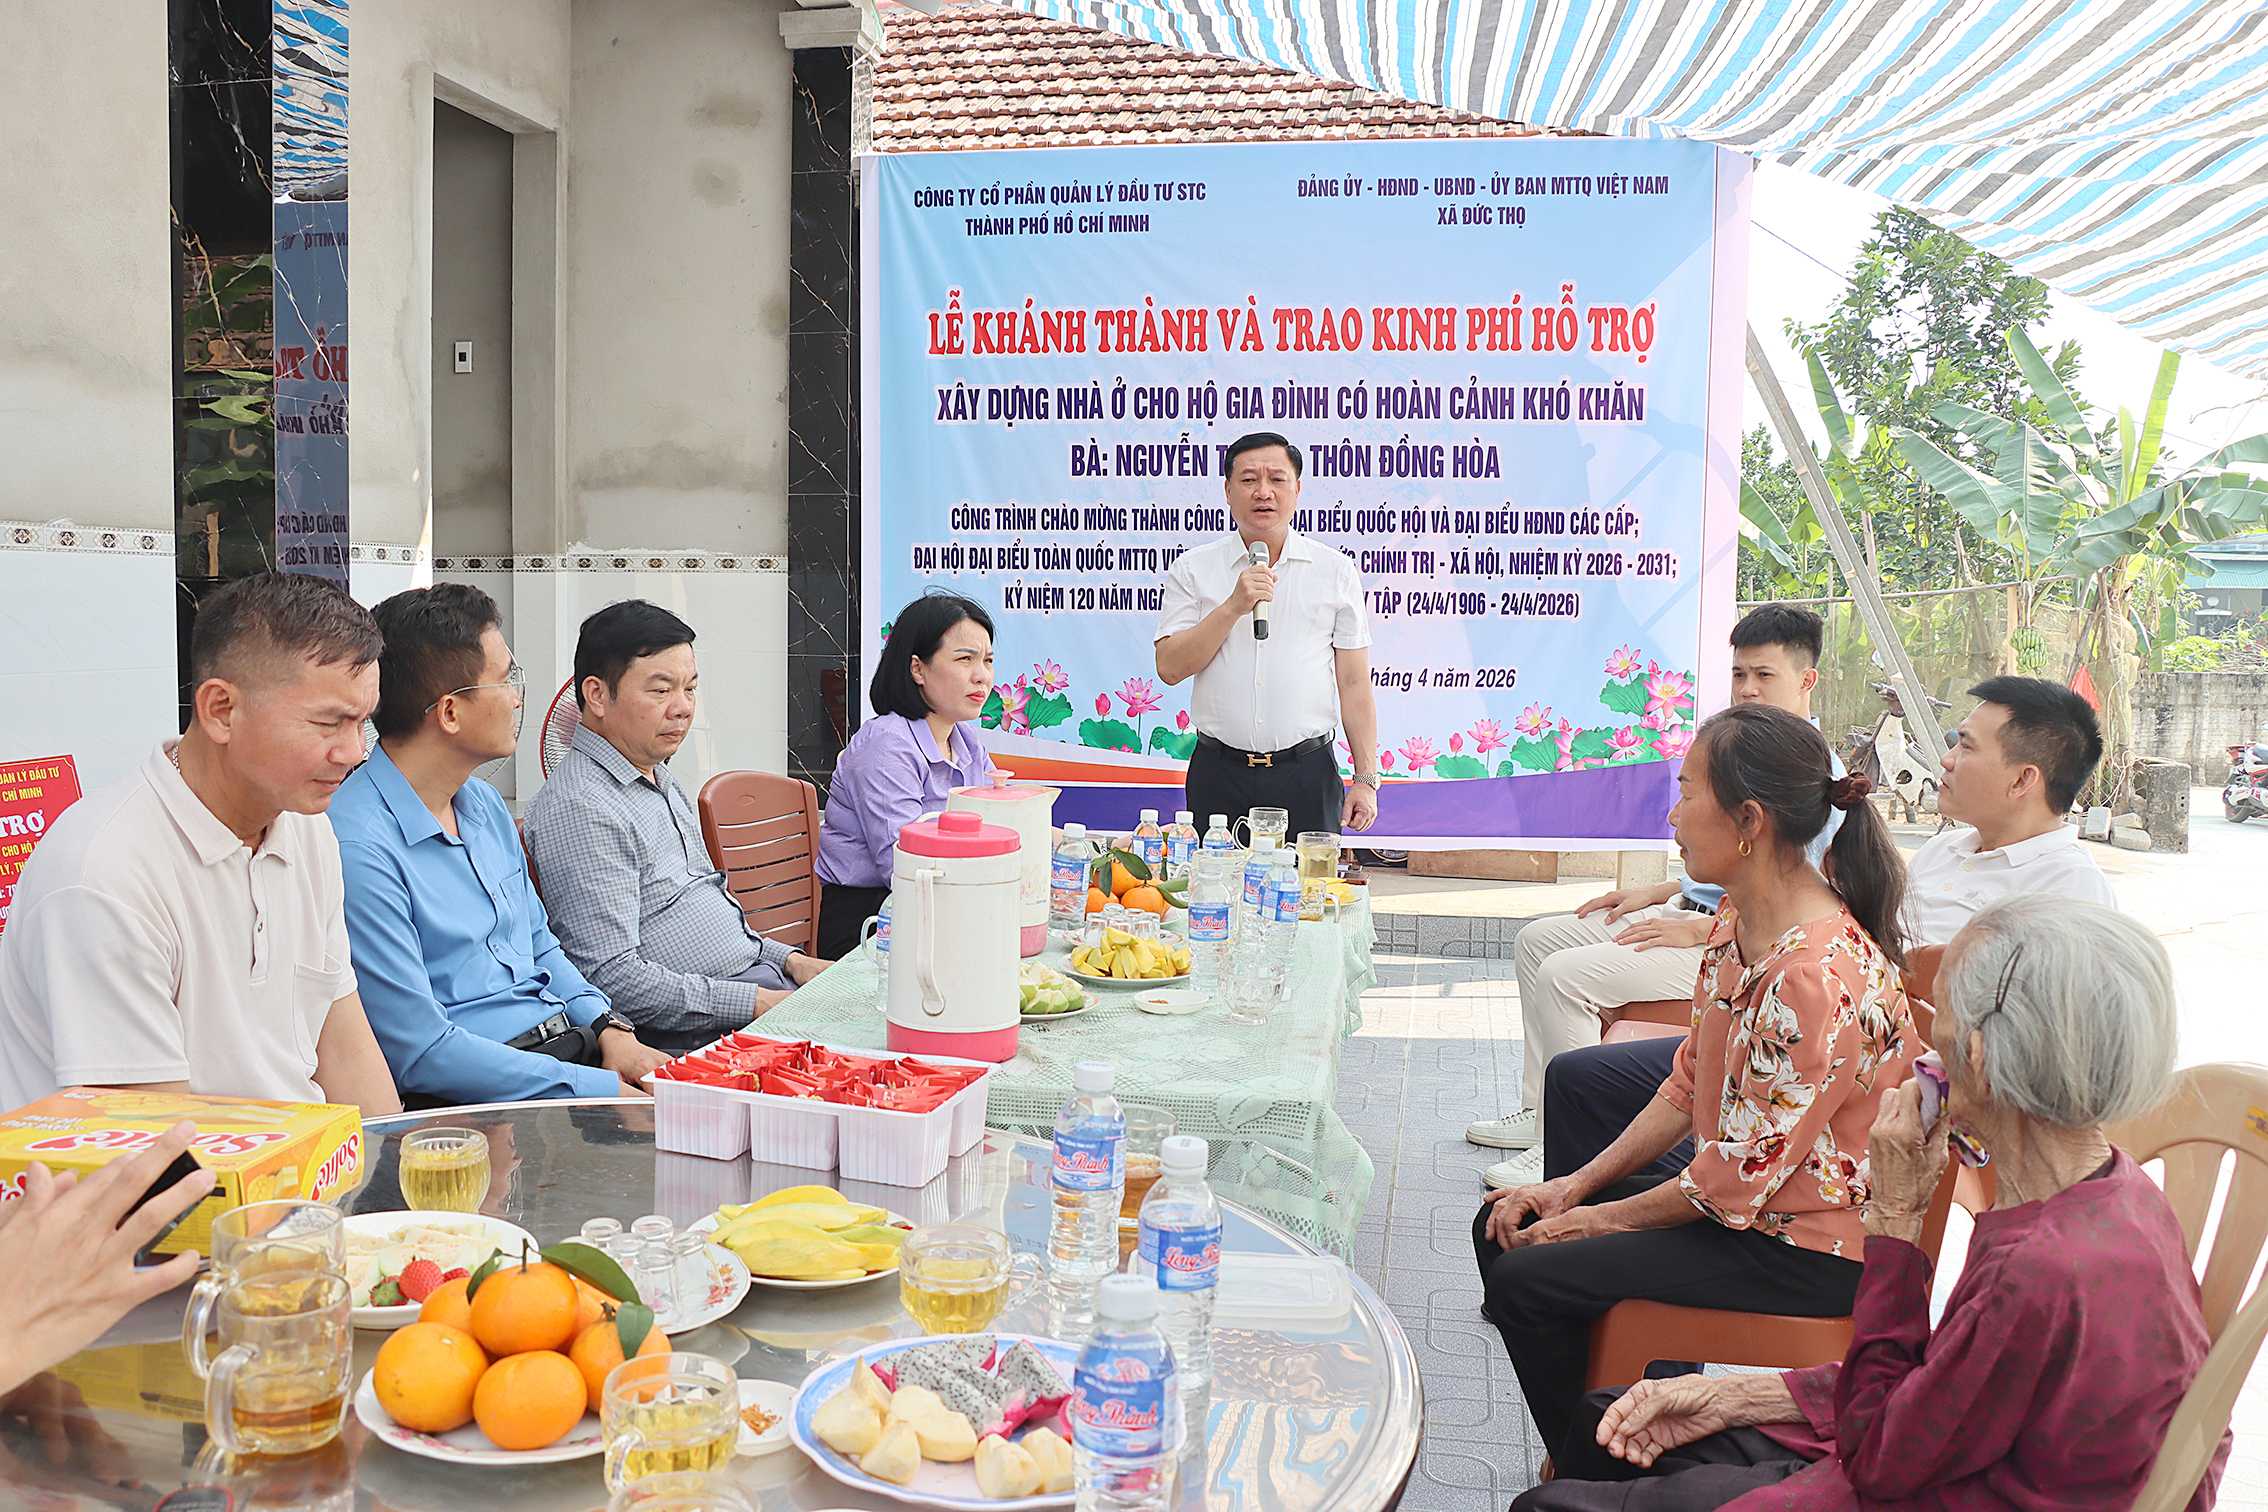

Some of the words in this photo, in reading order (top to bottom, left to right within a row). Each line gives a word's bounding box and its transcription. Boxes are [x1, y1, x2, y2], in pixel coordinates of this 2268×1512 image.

[914, 186, 954, 208] CÔNG
[958, 188, 976, 207] TY
[980, 180, 1001, 206] CỔ
[1004, 180, 1046, 205] PHẦN
[1050, 179, 1092, 206] QUẢN
[1096, 180, 1114, 203] LÝ
[1117, 177, 1149, 202] ĐẦU
[1153, 181, 1175, 202] TƯ
[1177, 182, 1206, 201] STC
[1297, 173, 1339, 198] ĐẢNG
[1343, 172, 1363, 197] ỦY
[1377, 178, 1419, 197] HĐND
[1434, 177, 1476, 196] UBND
[1491, 170, 1511, 196] ỦY
[1514, 176, 1546, 195] BAN
[1551, 176, 1592, 197] MTTQ
[1596, 172, 1629, 199] VIỆT
[1633, 176, 1669, 195] NAM
[965, 214, 1014, 237] THÀNH
[1019, 210, 1049, 235] PHỐ
[1053, 209, 1074, 234] HỒ
[1078, 211, 1104, 234] CHÍ
[1108, 214, 1150, 233] MINH
[1437, 203, 1458, 225] XÃ
[1461, 202, 1493, 225] ĐỨC
[1497, 206, 1526, 229] THỌ
[928, 289, 965, 356] LỄ
[972, 298, 1087, 355] KHÁNH
[1094, 296, 1209, 353] THÀNH
[1217, 295, 1265, 352] VÀ
[1272, 307, 1363, 352] TRAO
[1372, 307, 1457, 352] KINH
[1466, 293, 1523, 352] PHÍ
[1531, 284, 1579, 352] HỖ
[1587, 302, 1656, 363] TRỢ
[937, 381, 981, 421] XÂY
[987, 384, 1049, 428] DỰNG
[1056, 380, 1104, 420] NHÀ
[1111, 375, 1127, 420] Ở
[1133, 386, 1179, 420] CHO
[1187, 379, 1218, 427] HỘ
[1226, 386, 1265, 420] GIA
[1271, 379, 1329, 419] ĐÌNH
[1337, 379, 1368, 420] CÓ
[1376, 379, 1441, 420] HOÀN
[1449, 375, 1515, 420] CẢNH
[1523, 380, 1571, 421] KHÓ
[1578, 380, 1644, 421] KHĂN
[1071, 437, 1108, 478] BÀ:
[1115, 432, 1208, 478] NGUYỄN
[1309, 437, 1372, 478] THÔN
[1378, 433, 1445, 479] ĐỒNG
[1452, 437, 1501, 479] HÒA
[951, 502, 991, 531] CÔNG
[994, 502, 1037, 531] TRÌNH
[1041, 502, 1079, 531] CHÀO
[1083, 503, 1127, 531] MỪNG
[1131, 503, 1180, 531] THÀNH
[1184, 503, 1225, 532] CÔNG
[1317, 499, 1352, 533] BIỂU
[1356, 501, 1397, 536] QUỐC
[1401, 505, 1426, 539] HỘI
[1430, 505, 1451, 534] VÀ
[1454, 510, 1480, 539] ĐẠI
[1484, 501, 1519, 535] BIỂU
[1523, 511, 1565, 535] HĐND
[1570, 506, 1600, 536] CÁC
[1604, 503, 1639, 539] CẤP;
[913, 546, 937, 575] ĐẠI
[941, 542, 965, 575] HỘI
[968, 547, 993, 575] ĐẠI
[997, 538, 1030, 570] BIỂU
[1033, 542, 1071, 571] TOÀN
[1075, 539, 1114, 573] QUỐC
[1118, 548, 1158, 574] MTTQ
[1360, 545, 1407, 574] CHÍNH
[1411, 551, 1435, 580] TRỊ
[1449, 546, 1471, 575] XÃ
[1474, 546, 1504, 580] HỘI,
[1509, 547, 1559, 581] NHIỆM
[1563, 547, 1583, 576] KỲ
[1586, 552, 1623, 576] 2026
[1636, 552, 1677, 579] 2031;
[1005, 579, 1023, 609] KỶ
[1027, 582, 1064, 615] NIỆM
[1068, 587, 1095, 610] 120
[1099, 582, 1133, 611] NĂM
[1373, 586, 1402, 619] TẬP
[1407, 591, 1486, 617] (24/4/1906
[1500, 592, 1580, 618] 24/4/2026)
[1370, 666, 1413, 693] háng
[1417, 668, 1428, 687] 4
[1433, 668, 1470, 688] năm
[1474, 668, 1517, 688] 2026
[18, 786, 44, 800] MINH
[1, 844, 20, 858] CHO
[317, 1131, 360, 1192] Solite
[1071, 1151, 1110, 1171] Thành
[1160, 1246, 1200, 1272] Long
[1100, 1399, 1159, 1427] Thành
